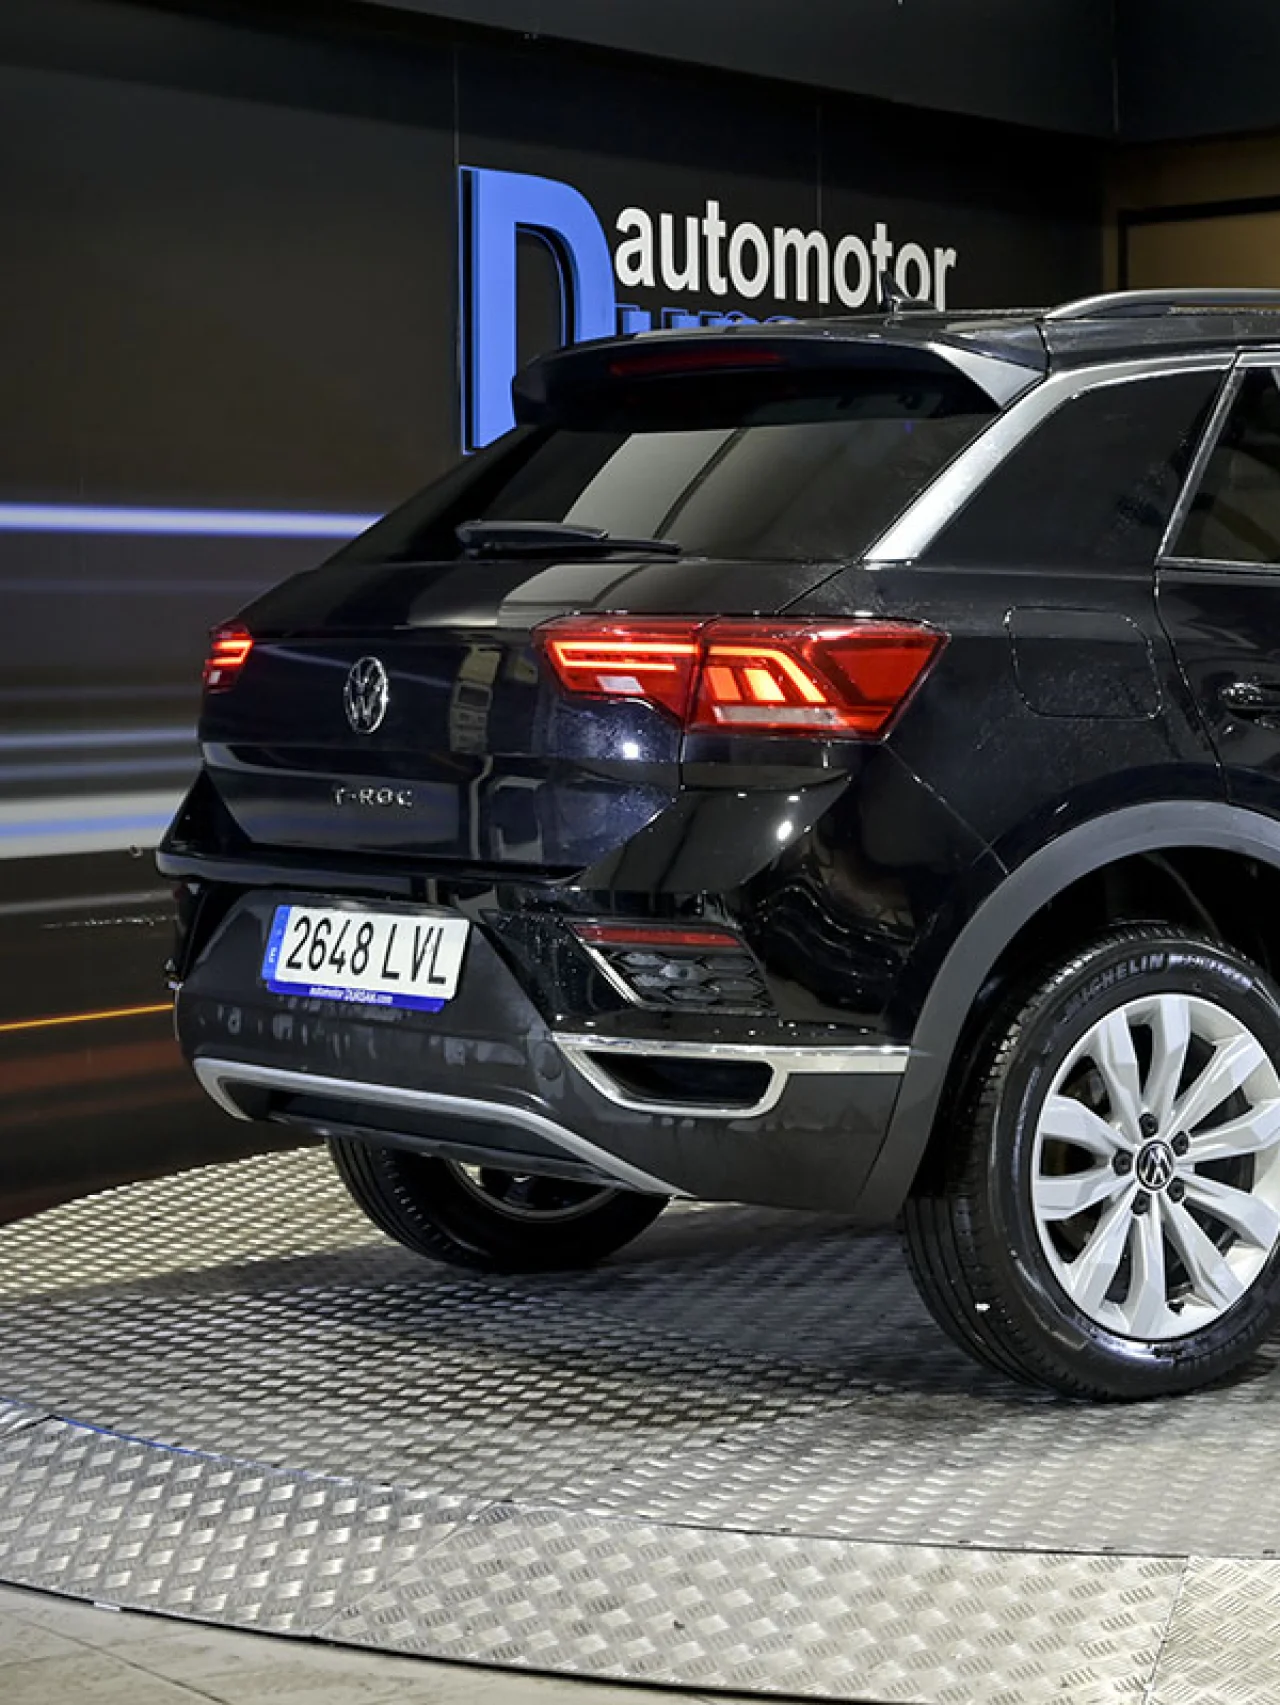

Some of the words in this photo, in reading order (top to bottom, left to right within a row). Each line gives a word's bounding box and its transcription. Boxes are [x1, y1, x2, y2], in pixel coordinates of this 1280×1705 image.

[615, 200, 957, 312] automotor
[286, 915, 374, 975] 2648
[381, 923, 447, 985] LVL
